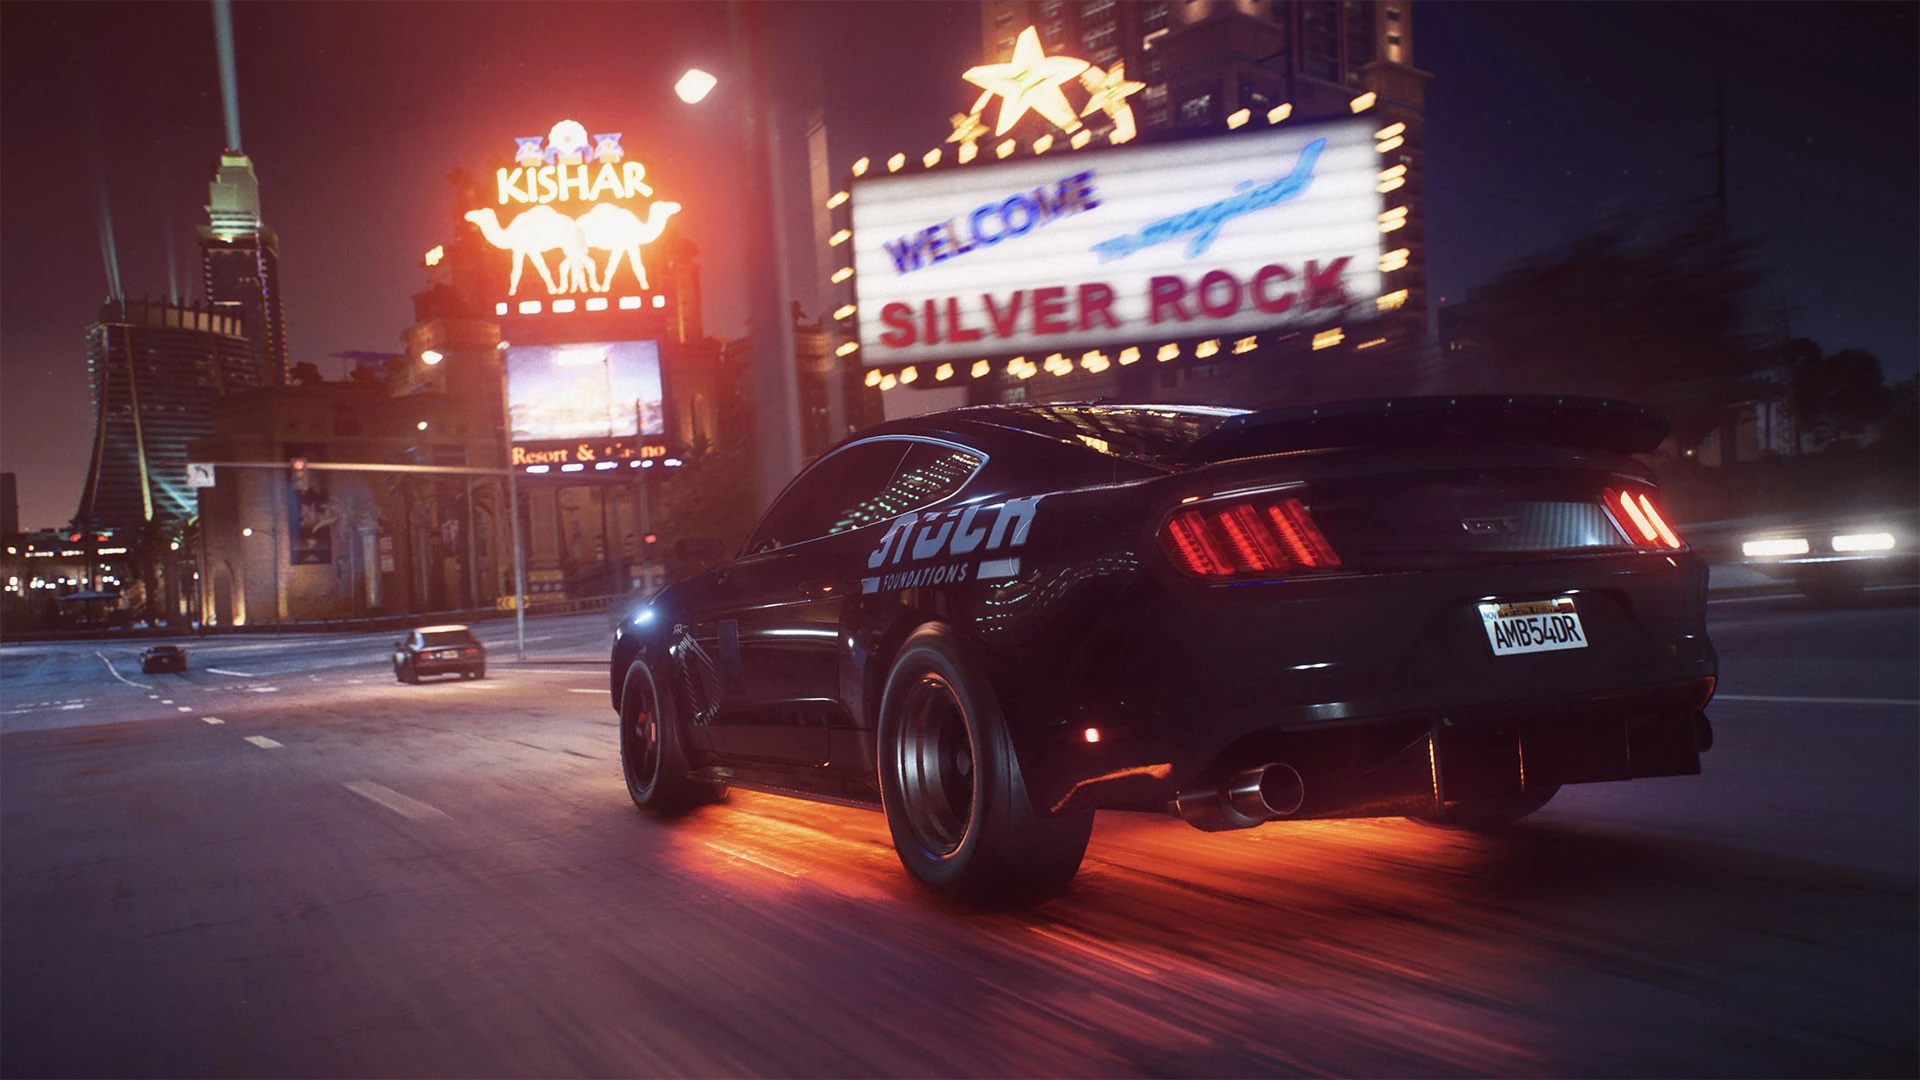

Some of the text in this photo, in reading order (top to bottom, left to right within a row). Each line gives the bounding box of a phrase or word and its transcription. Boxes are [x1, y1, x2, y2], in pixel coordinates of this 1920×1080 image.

[496, 161, 653, 204] KISHAR
[882, 168, 1101, 276] WELCOME
[879, 255, 1354, 349] SILVER ROCK
[511, 446, 568, 465] Resort
[576, 444, 595, 461] &
[882, 561, 969, 592] FOUNDATIONS
[1483, 611, 1498, 621] NOV
[1494, 616, 1581, 648] AMB54DR
